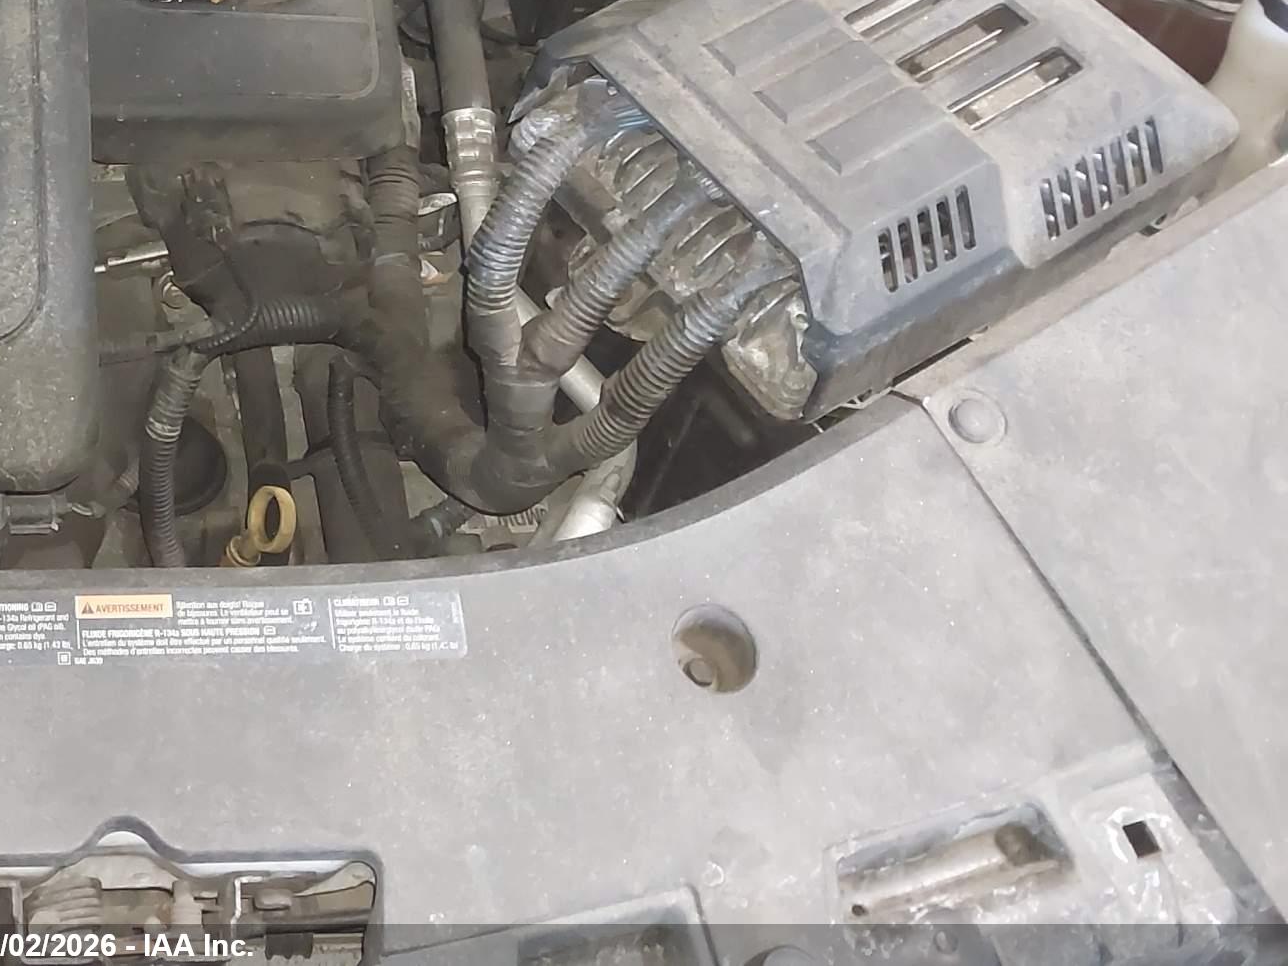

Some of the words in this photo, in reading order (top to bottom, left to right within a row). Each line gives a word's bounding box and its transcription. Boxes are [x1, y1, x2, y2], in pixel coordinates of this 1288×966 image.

[96, 604, 163, 614] AVERTISSEMENT
[20, 614, 55, 623] Refrigerant
[56, 613, 69, 622] and
[28, 623, 36, 631] oil
[34, 641, 42, 650] kg
